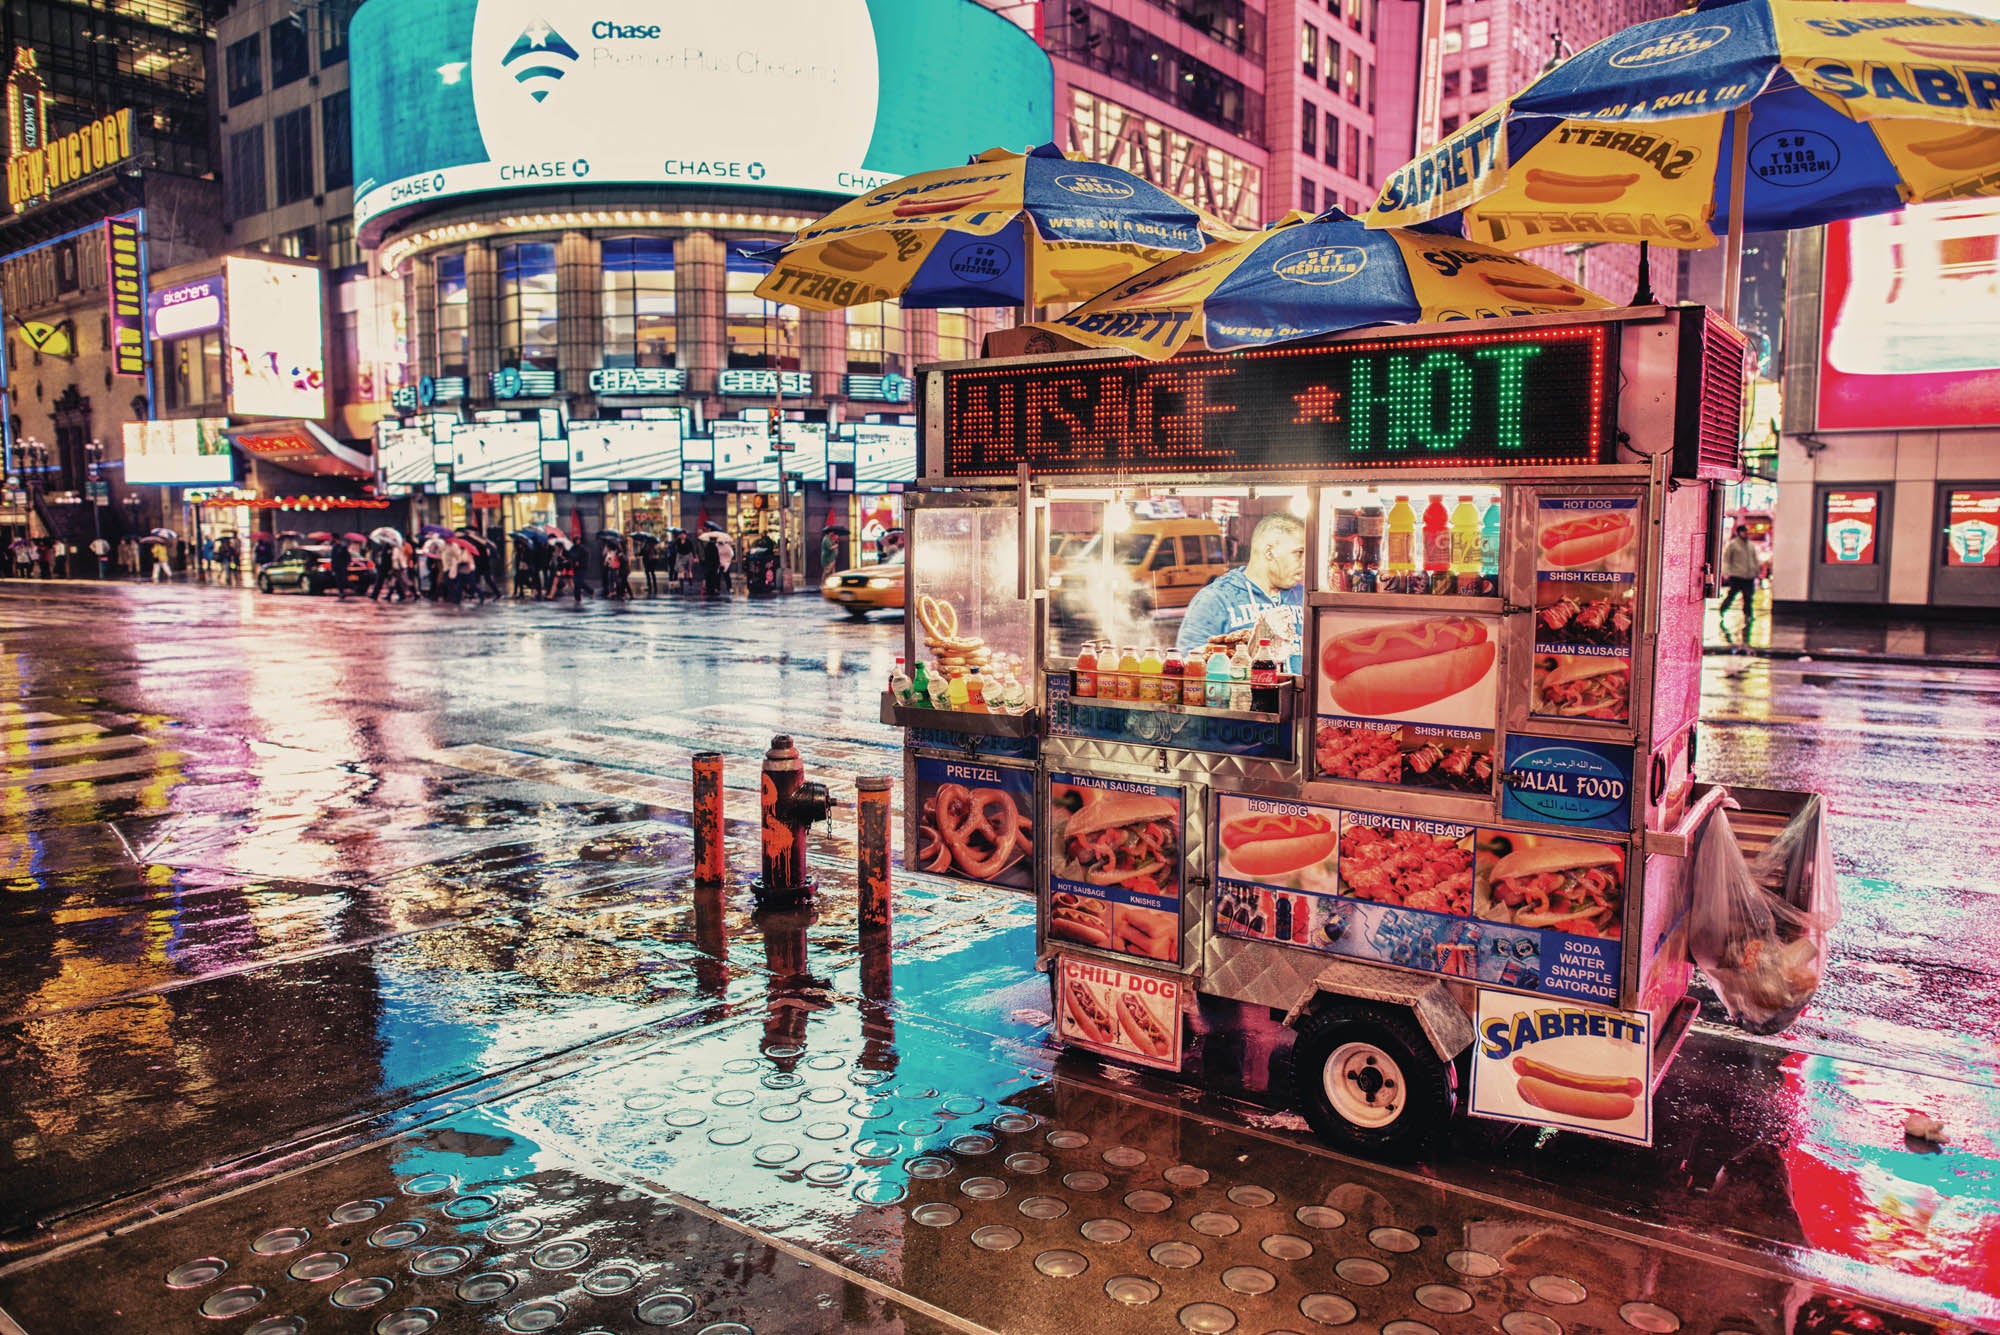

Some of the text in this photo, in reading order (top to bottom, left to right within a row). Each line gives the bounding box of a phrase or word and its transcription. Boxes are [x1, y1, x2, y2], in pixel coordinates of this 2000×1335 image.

[591, 20, 661, 39] Chase
[1803, 16, 1989, 38] SABRETT
[1595, 102, 1628, 118] ON
[1627, 100, 1647, 115] A
[1652, 88, 1708, 110] ROLL
[1713, 83, 1748, 101] !!!
[7, 107, 131, 205] NEW VICTORY
[1377, 117, 1502, 213] SABRETT
[500, 161, 567, 181] CHASE
[664, 159, 742, 178] CHASE
[390, 181, 431, 202] CHASE
[864, 172, 1012, 208] SABRETT
[1049, 217, 1188, 241] WE'RE ON A ROLL !!!
[112, 223, 144, 372] NEW VICTORY
[1219, 325, 1275, 338] WE'RE
[589, 368, 683, 392] CHASE
[719, 370, 813, 395] CHASE
[1350, 346, 1543, 452] HOT
[1563, 500, 1612, 509] HOT DOG
[1549, 572, 1622, 582] SHISH KEBAB
[1536, 643, 1630, 657] ITALIAN SAUSAGE
[1321, 717, 1397, 733] CHICKEN KEBAB
[1414, 726, 1482, 740] SHISH KEBAB
[946, 764, 1002, 783] PRETZEL
[1512, 768, 1625, 800] HALAL FOOD
[1072, 776, 1157, 796] ITALIAN SAUSAGE
[1248, 798, 1309, 818] HOT DOG
[1348, 811, 1467, 838] CHICKEN KEBAB
[1057, 882, 1106, 898] HOT SAUSAGE
[1129, 895, 1161, 908] KNISHES
[1564, 940, 1602, 956] SODA
[1559, 952, 1605, 970] WATER
[1065, 962, 1175, 999] CHILI DOG
[1551, 964, 1612, 985] SNAPPLE
[1544, 975, 1618, 999] GATORADE
[1480, 1007, 1646, 1060] SABRETT
